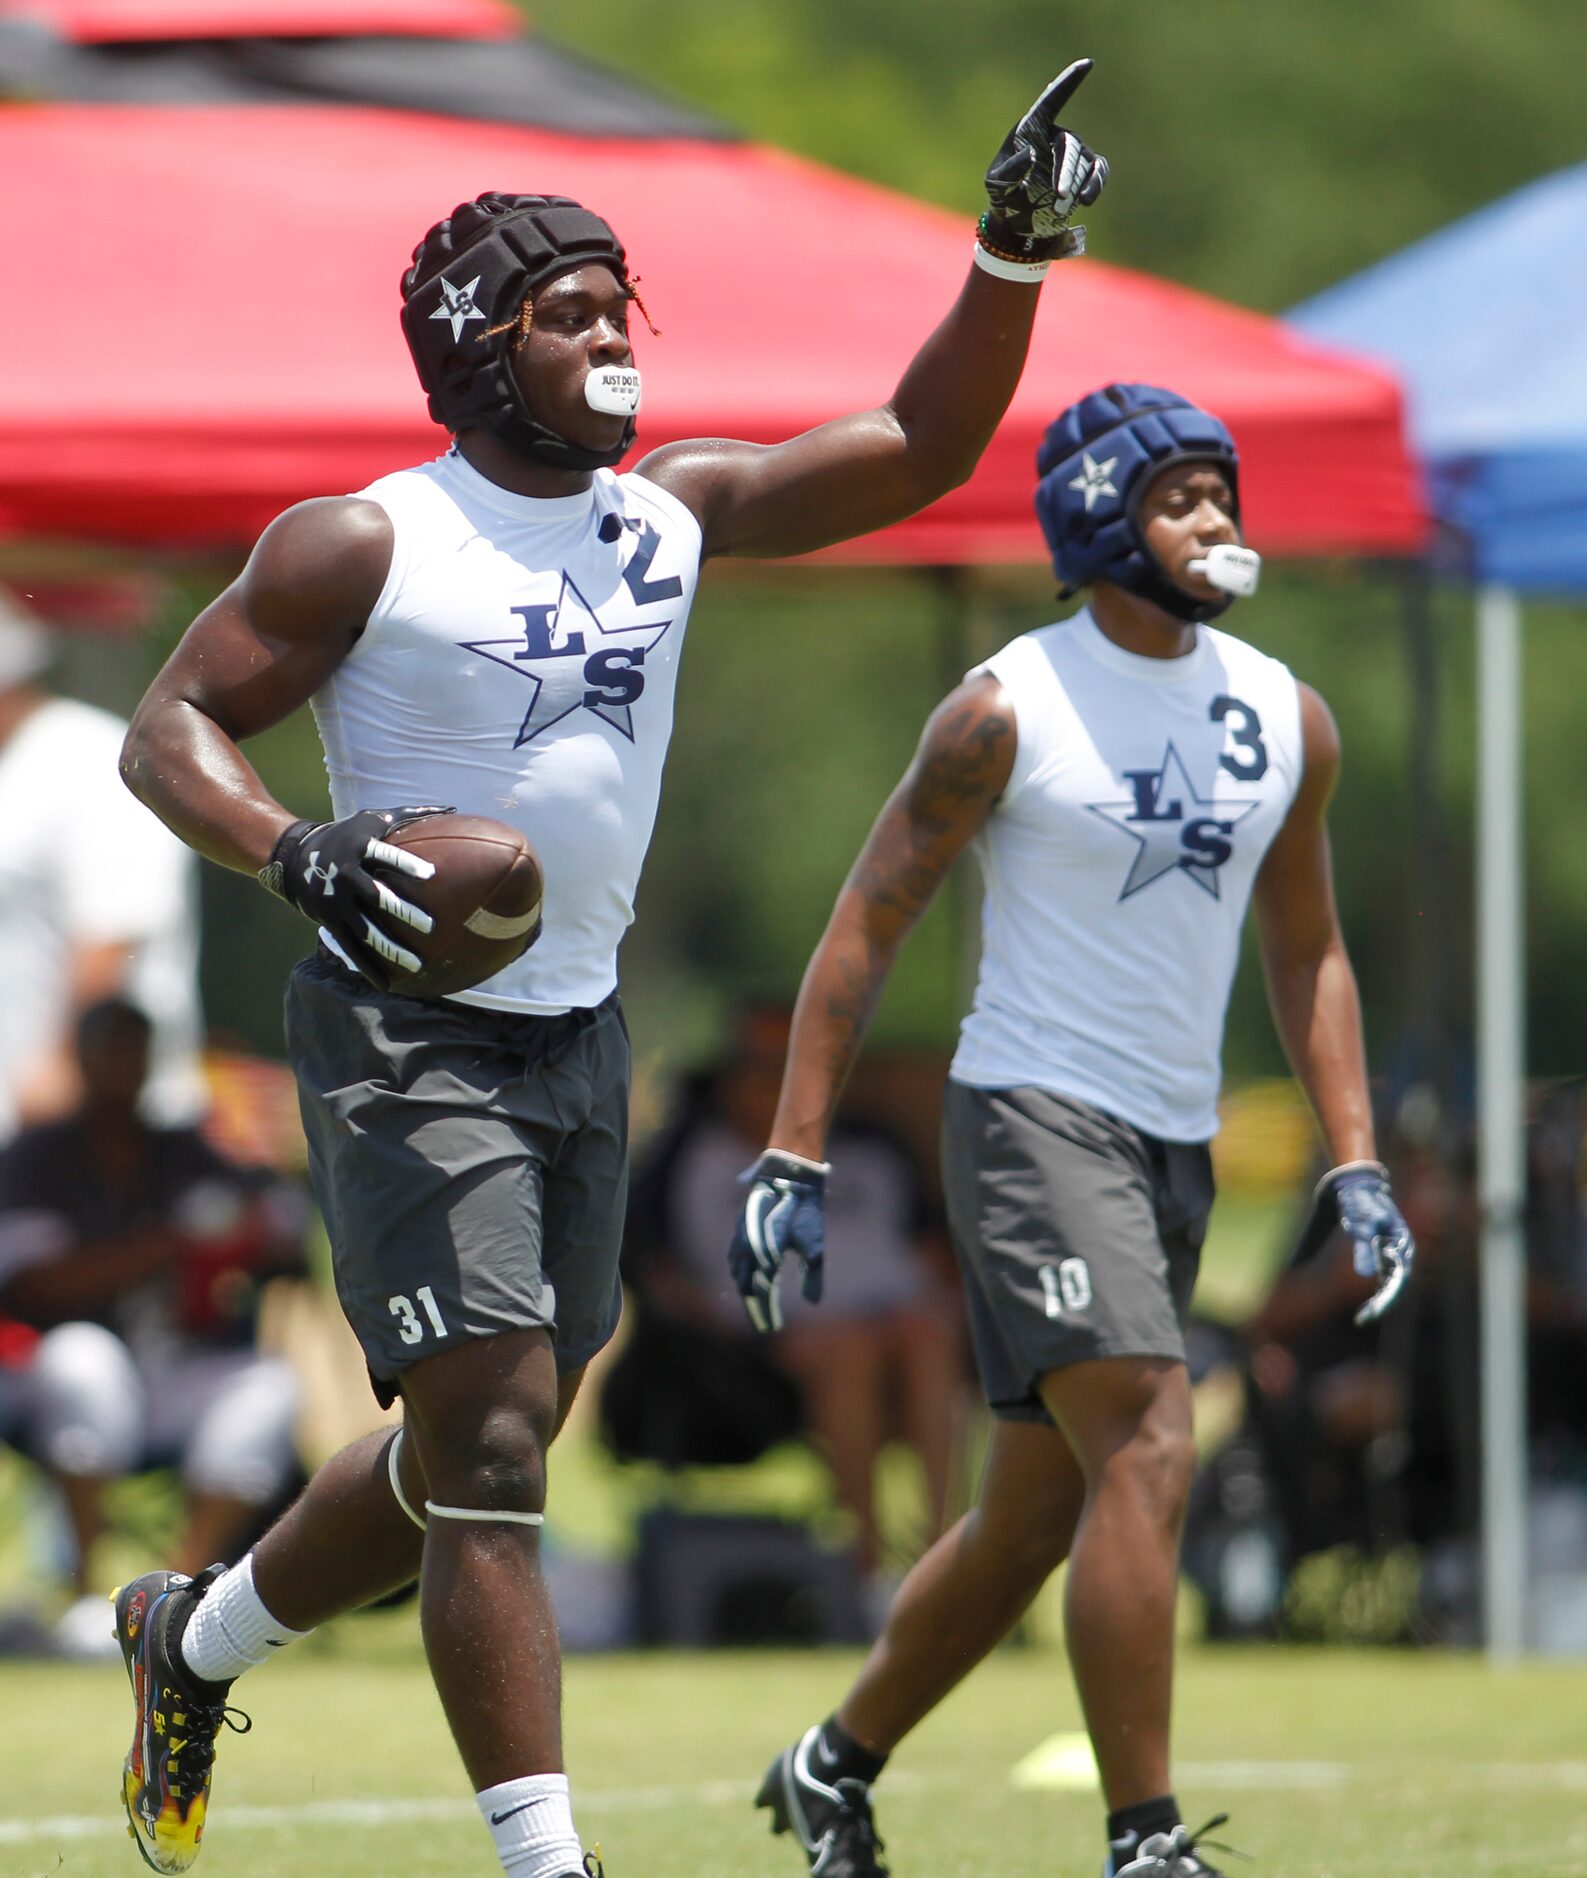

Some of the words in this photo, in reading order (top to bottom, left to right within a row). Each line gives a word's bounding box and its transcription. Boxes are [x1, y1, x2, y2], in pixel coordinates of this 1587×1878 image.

[602, 375, 621, 386] JUST
[622, 376, 633, 386] DO
[1209, 694, 1268, 781] 3
[388, 1286, 448, 1345] 31
[1038, 1256, 1093, 1319] 10
